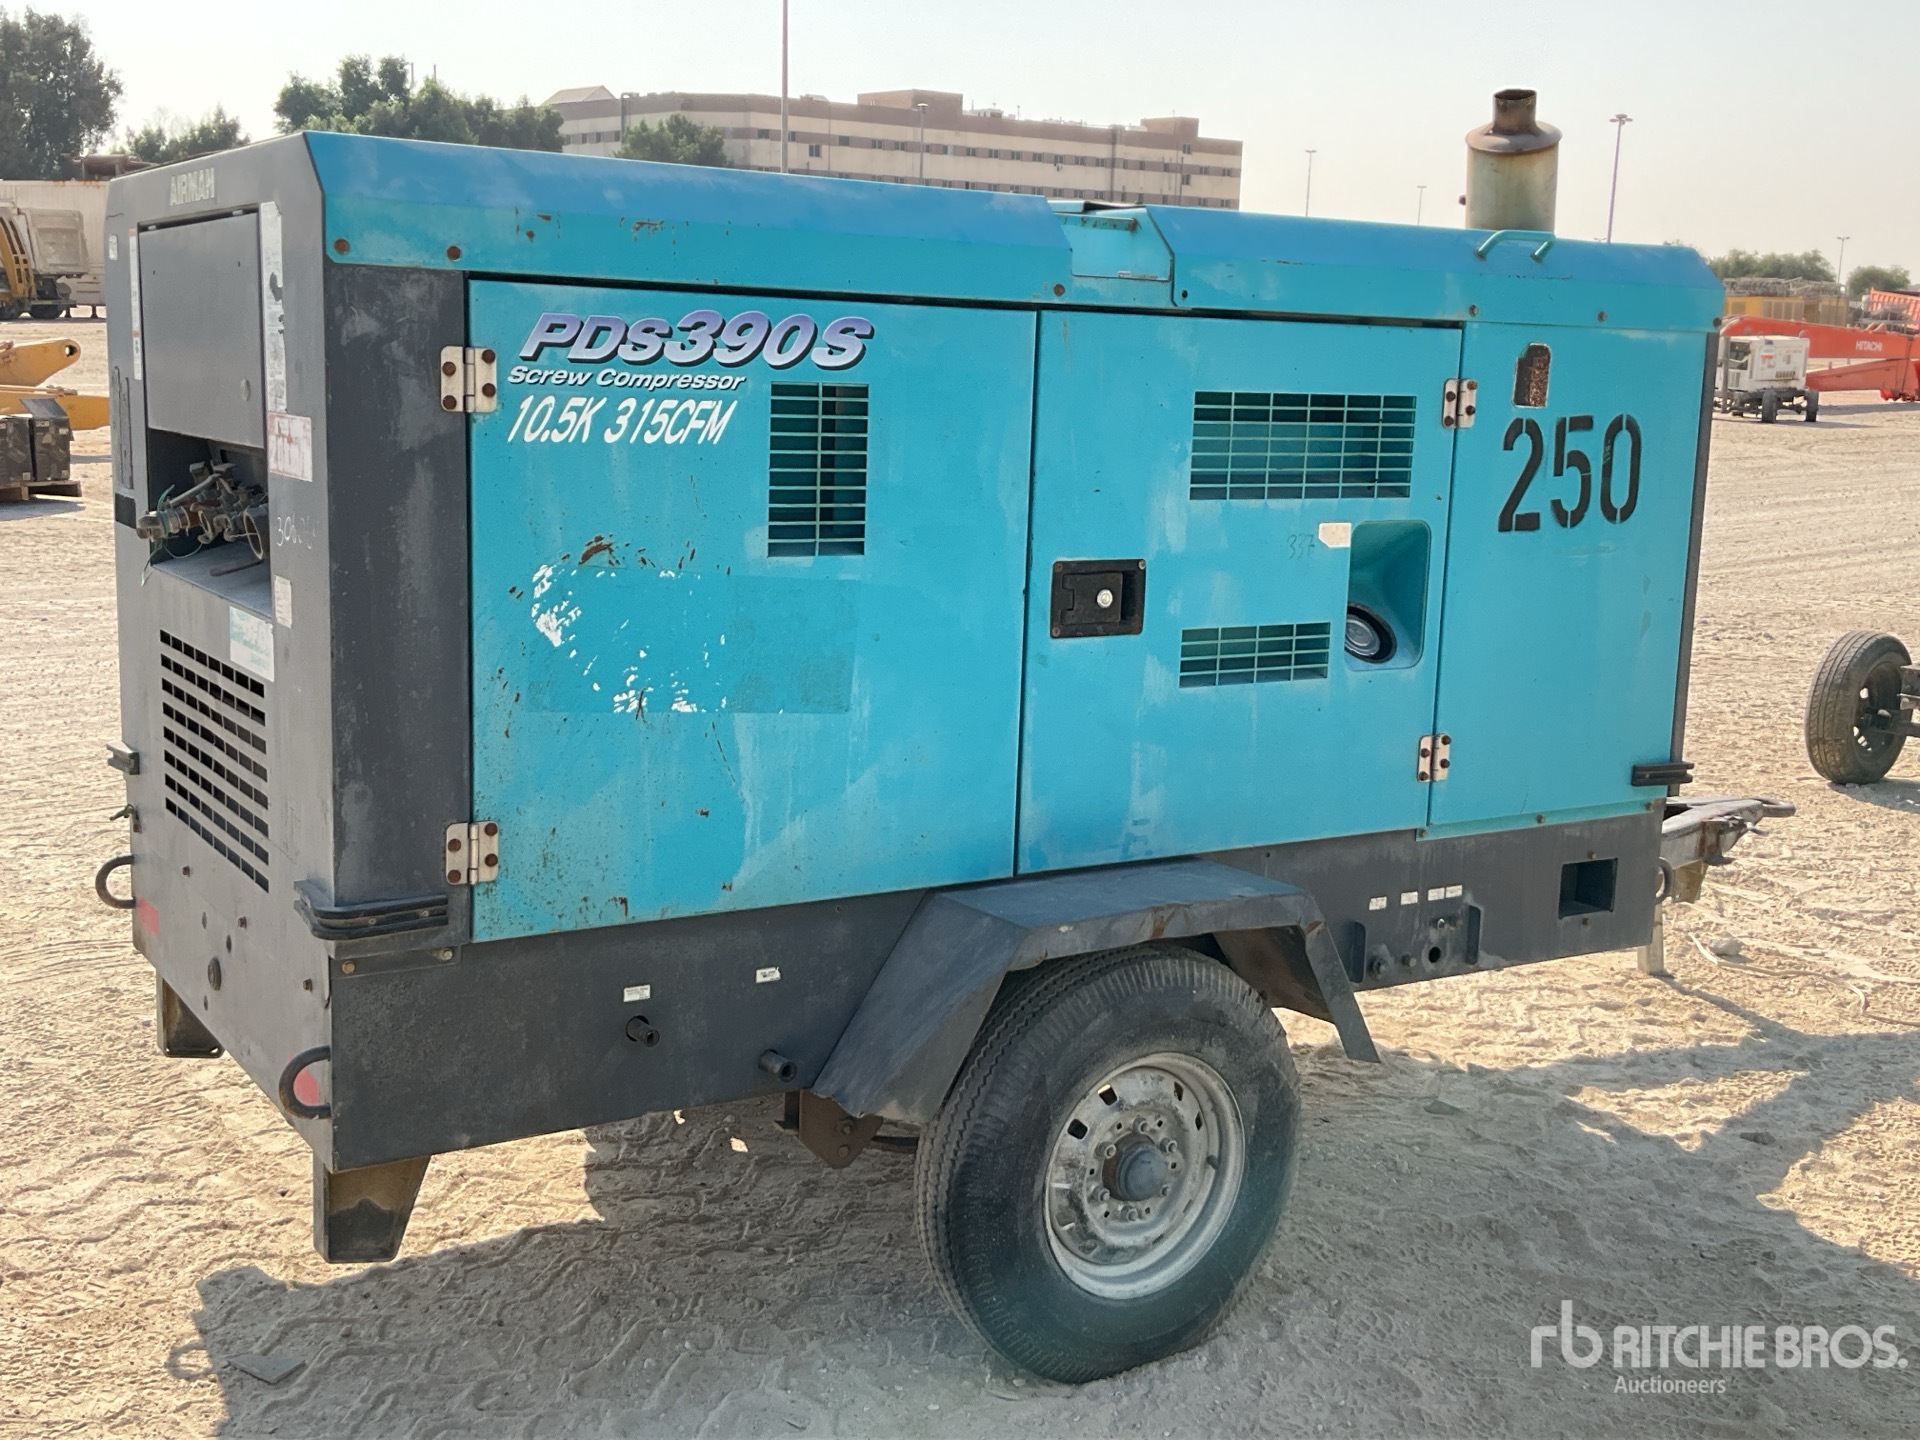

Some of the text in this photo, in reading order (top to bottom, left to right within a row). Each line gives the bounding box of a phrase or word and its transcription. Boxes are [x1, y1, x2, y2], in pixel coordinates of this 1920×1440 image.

[519, 310, 875, 370] PDS390S
[1855, 340, 1883, 352] HITACHI
[507, 365, 747, 391] Screw Compressor
[507, 395, 739, 445] 10.5K 315CFM
[1498, 413, 1643, 533] 250
